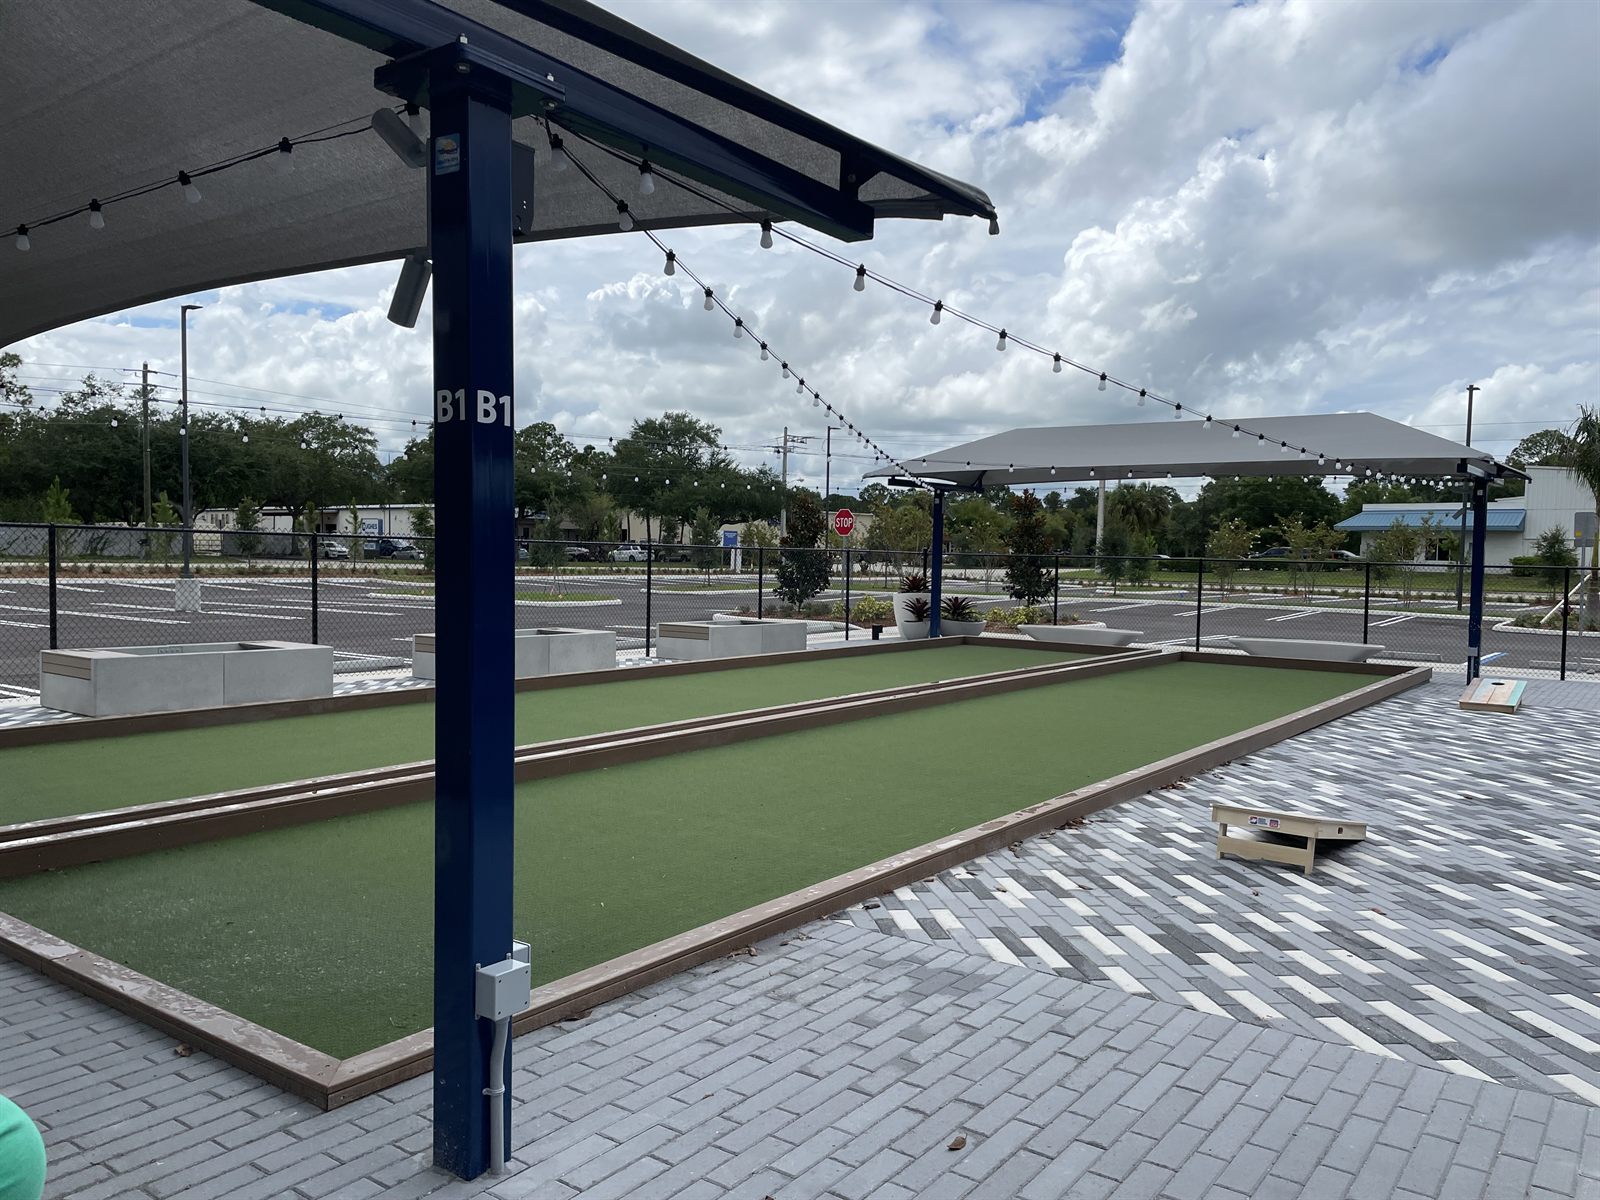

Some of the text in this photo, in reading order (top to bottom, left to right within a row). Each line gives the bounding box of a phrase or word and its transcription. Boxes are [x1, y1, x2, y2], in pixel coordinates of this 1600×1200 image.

[436, 388, 466, 423] B1
[477, 389, 511, 427] B1
[835, 517, 853, 528] STOP
